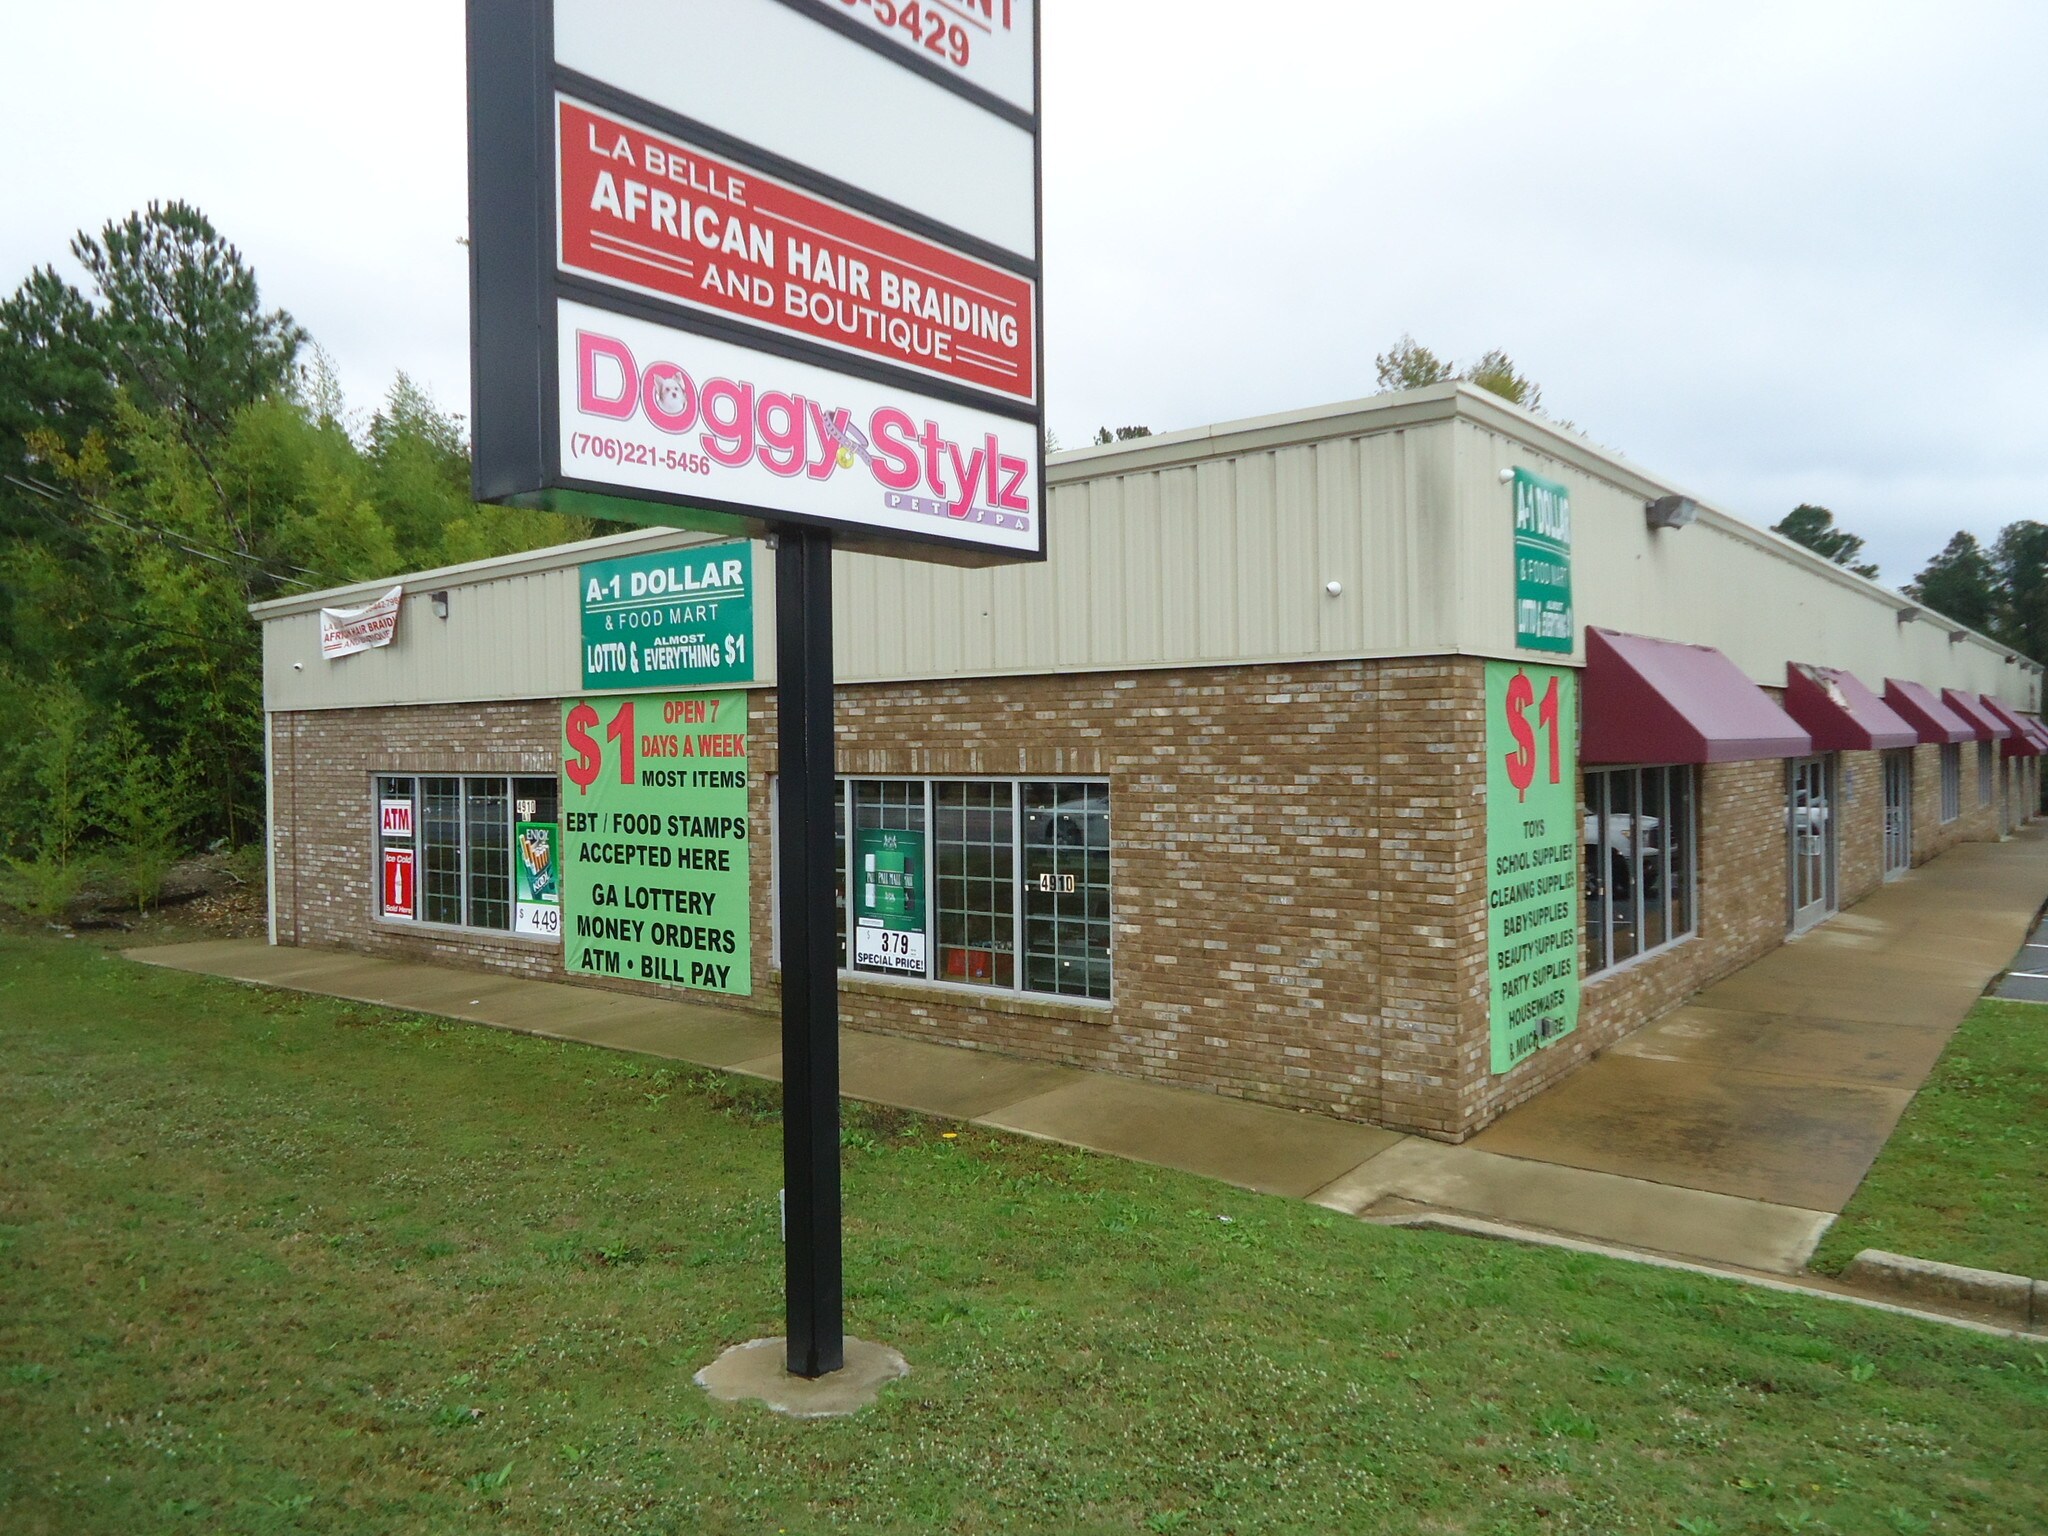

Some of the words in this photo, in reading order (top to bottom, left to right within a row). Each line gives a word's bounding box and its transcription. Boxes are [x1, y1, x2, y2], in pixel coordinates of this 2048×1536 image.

[589, 123, 636, 167] LA
[645, 144, 746, 207] BELLE
[590, 170, 774, 269] AFRICAN
[787, 237, 870, 301] HAIR
[880, 271, 1018, 348] BRAIDING
[701, 263, 775, 307] AND
[784, 282, 952, 363] BOUTIQUE
[571, 432, 710, 476] (706)221-5456
[891, 494, 941, 515] PET
[976, 511, 1024, 530] SPA
[586, 574, 620, 602] A-1
[631, 559, 743, 596] DOLLAR
[605, 614, 613, 630] &
[619, 609, 662, 629] FOOD
[669, 604, 718, 624] MART
[588, 642, 626, 673] LOTTO
[630, 641, 639, 673] &
[645, 643, 720, 671] EVERYTHING
[724, 633, 745, 667] $1
[654, 634, 705, 646] ALMOST
[565, 700, 635, 795] $1
[663, 701, 705, 724] OPEN
[710, 700, 720, 723] 7
[641, 735, 678, 757] DAYS
[683, 735, 694, 757] A
[698, 734, 745, 757] WEEK
[1505, 667, 1560, 803] $1
[642, 771, 687, 788] MOST
[693, 771, 746, 789] ITEMS
[384, 808, 410, 830] ATM
[566, 812, 598, 833] EBT
[613, 813, 661, 835] FOOD
[668, 815, 746, 839] STAMPS
[1523, 819, 1545, 839] TOYS
[386, 854, 395, 863] Ice
[397, 855, 412, 864] Cold
[579, 842, 671, 868] ACCEPTED
[678, 848, 730, 872] HERE
[1532, 843, 1573, 868] SUPPLIES
[1041, 874, 1073, 891] 4910
[1537, 871, 1574, 896] SUPPLIES
[386, 904, 397, 913] Sold
[399, 905, 412, 914] Here
[592, 883, 618, 907] GA
[625, 886, 716, 916] LOTTERY
[577, 915, 644, 942] MONEY
[651, 923, 736, 954] ORDERS
[1504, 914, 1527, 937] BABY
[1528, 902, 1569, 928] SUPPLIES
[858, 952, 893, 966] SPECIAL
[895, 956, 924, 970] PRICE!
[1497, 942, 1533, 970] BEAUTY
[1534, 928, 1574, 956] SUPPLIES
[581, 948, 620, 973] ATM
[641, 955, 684, 983] BILL
[691, 961, 731, 988] PAY
[1502, 973, 1531, 1000] PARTY
